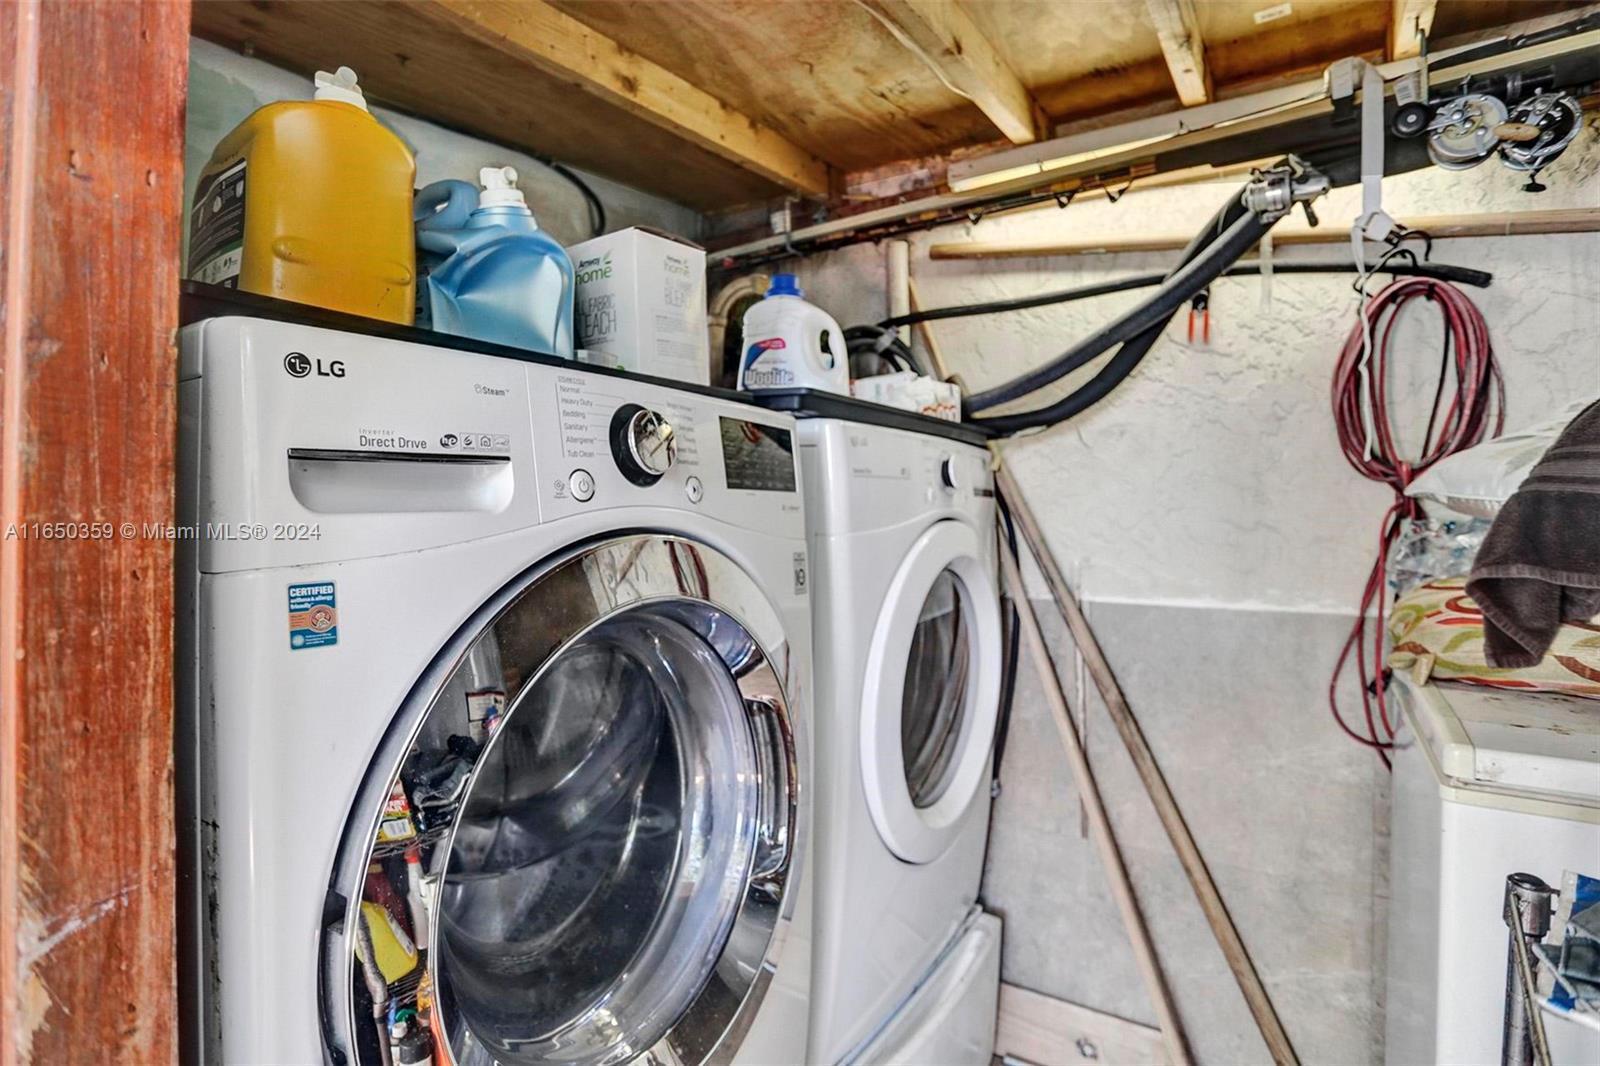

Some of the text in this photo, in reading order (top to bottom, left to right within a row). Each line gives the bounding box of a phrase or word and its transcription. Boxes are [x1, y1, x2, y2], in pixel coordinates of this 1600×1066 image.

[578, 257, 601, 269] Amway
[316, 358, 346, 378] LG
[744, 368, 795, 386] Woolite
[559, 385, 580, 394] Normal
[562, 409, 586, 420] Bedding
[563, 422, 588, 432] Sanitary
[359, 435, 427, 449] Direct Drive
[579, 450, 595, 458] Clean
[289, 585, 334, 597] CERTIFIED
